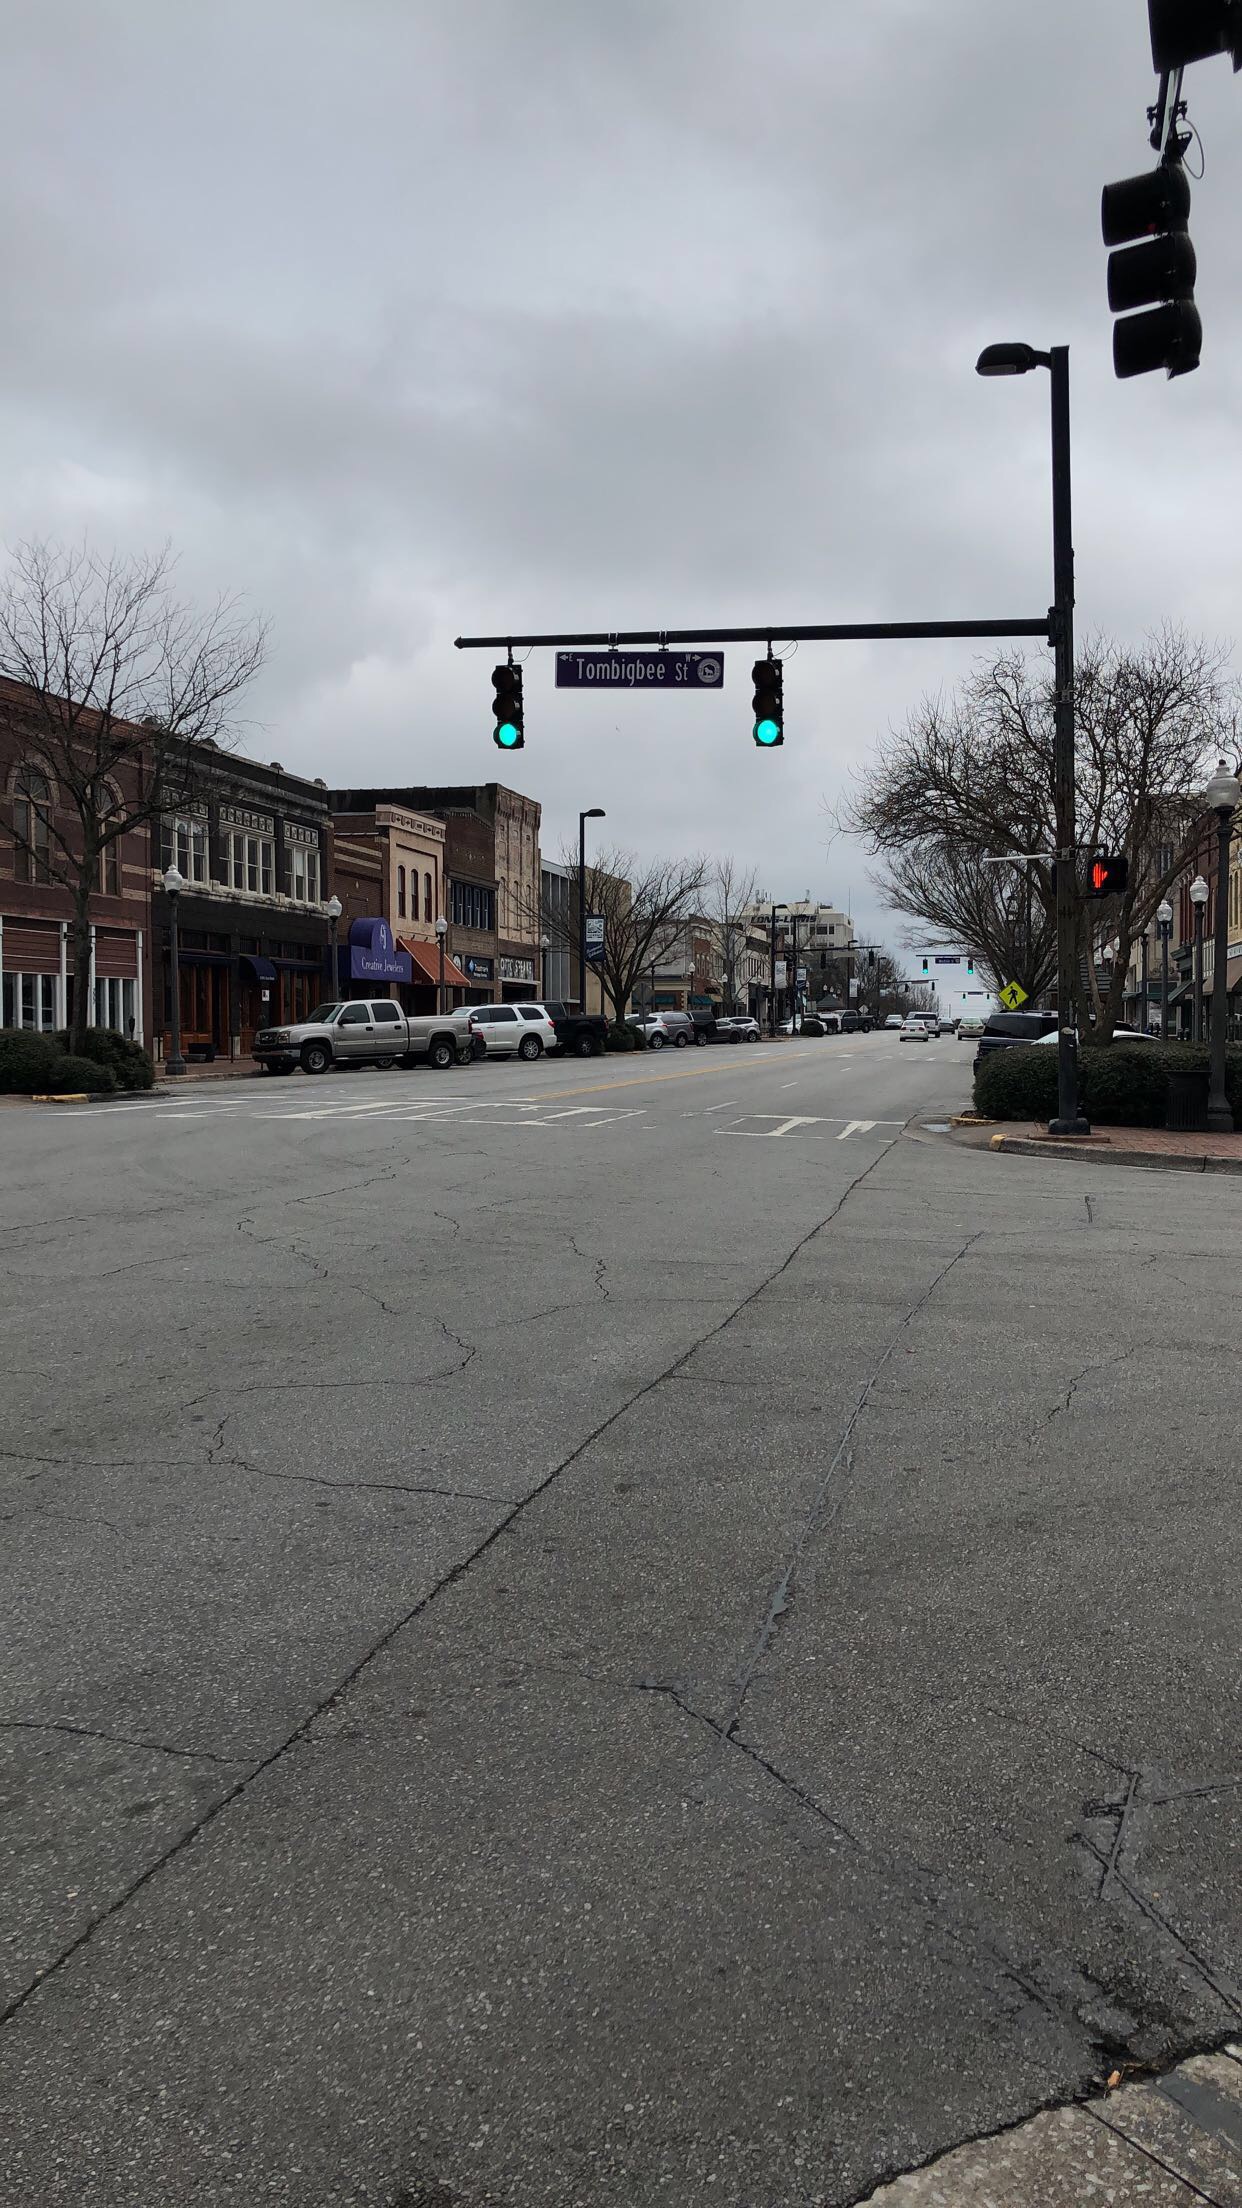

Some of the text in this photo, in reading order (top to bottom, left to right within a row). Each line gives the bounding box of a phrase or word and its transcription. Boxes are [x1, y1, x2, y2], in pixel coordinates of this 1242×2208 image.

[576, 658, 666, 686] Tombigbee
[675, 662, 689, 681] St
[361, 956, 404, 973] Creative Jewelers
